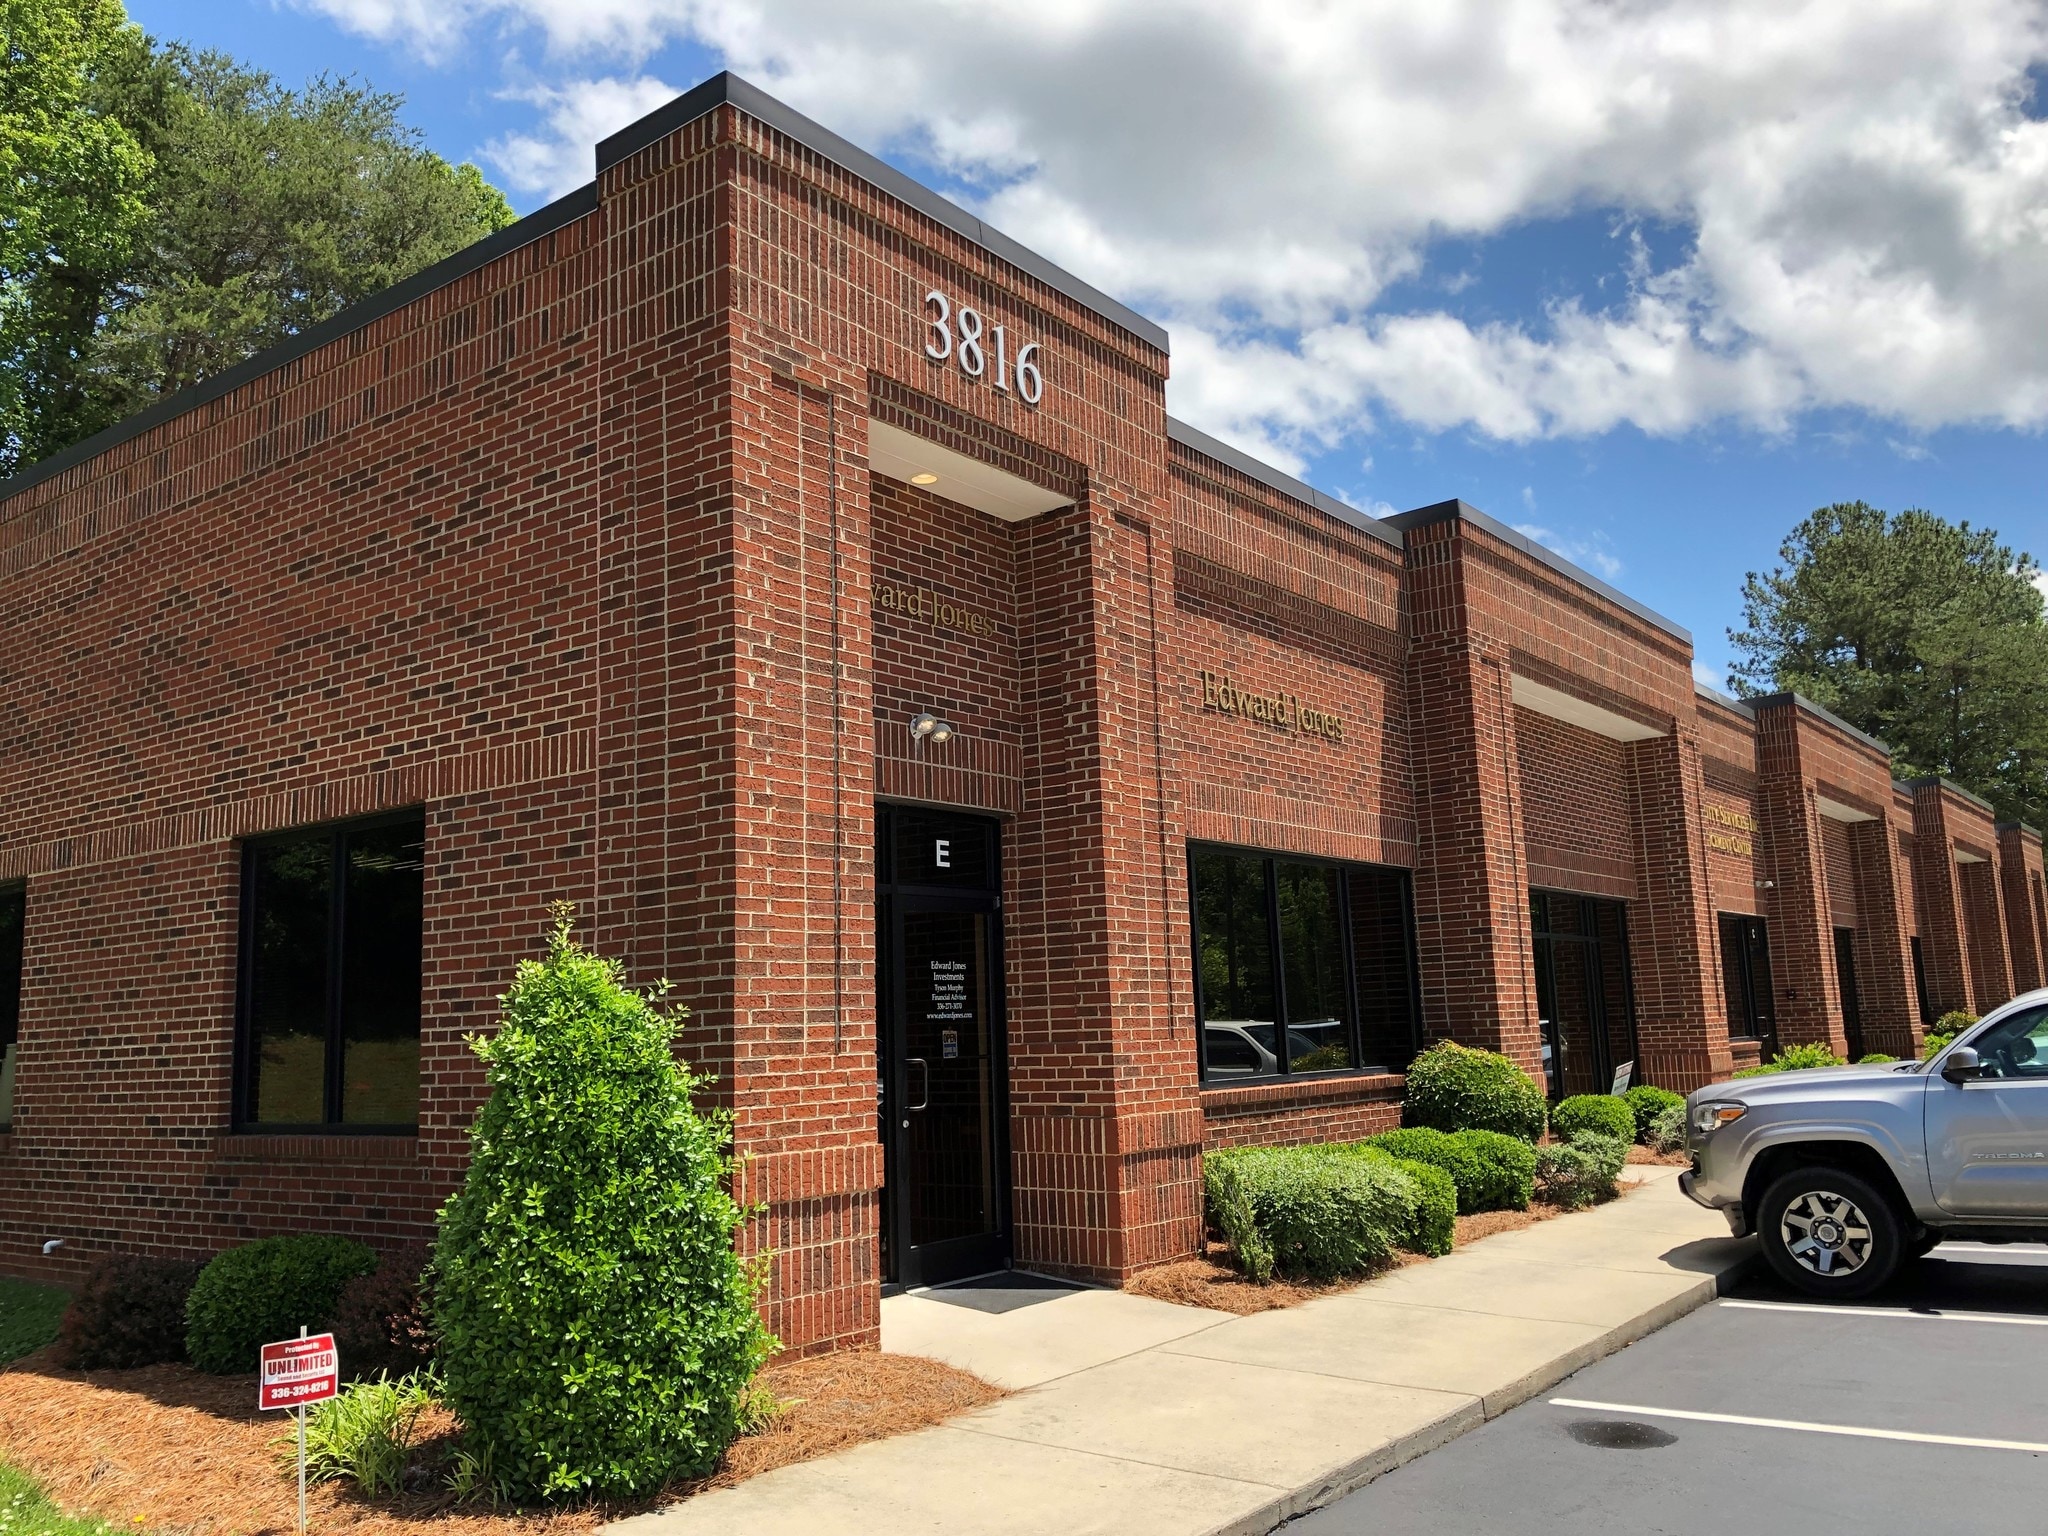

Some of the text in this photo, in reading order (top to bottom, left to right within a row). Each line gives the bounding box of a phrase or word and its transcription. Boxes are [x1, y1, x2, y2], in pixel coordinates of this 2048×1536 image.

[925, 290, 1043, 404] 3816
[930, 590, 994, 638] Jones
[1202, 670, 1344, 739] Edward Jones
[936, 839, 950, 868] E
[930, 961, 967, 971] Edward Jones
[933, 972, 965, 981] Investments
[931, 993, 950, 1001] Financial
[267, 1353, 332, 1376] UNLIMITED
